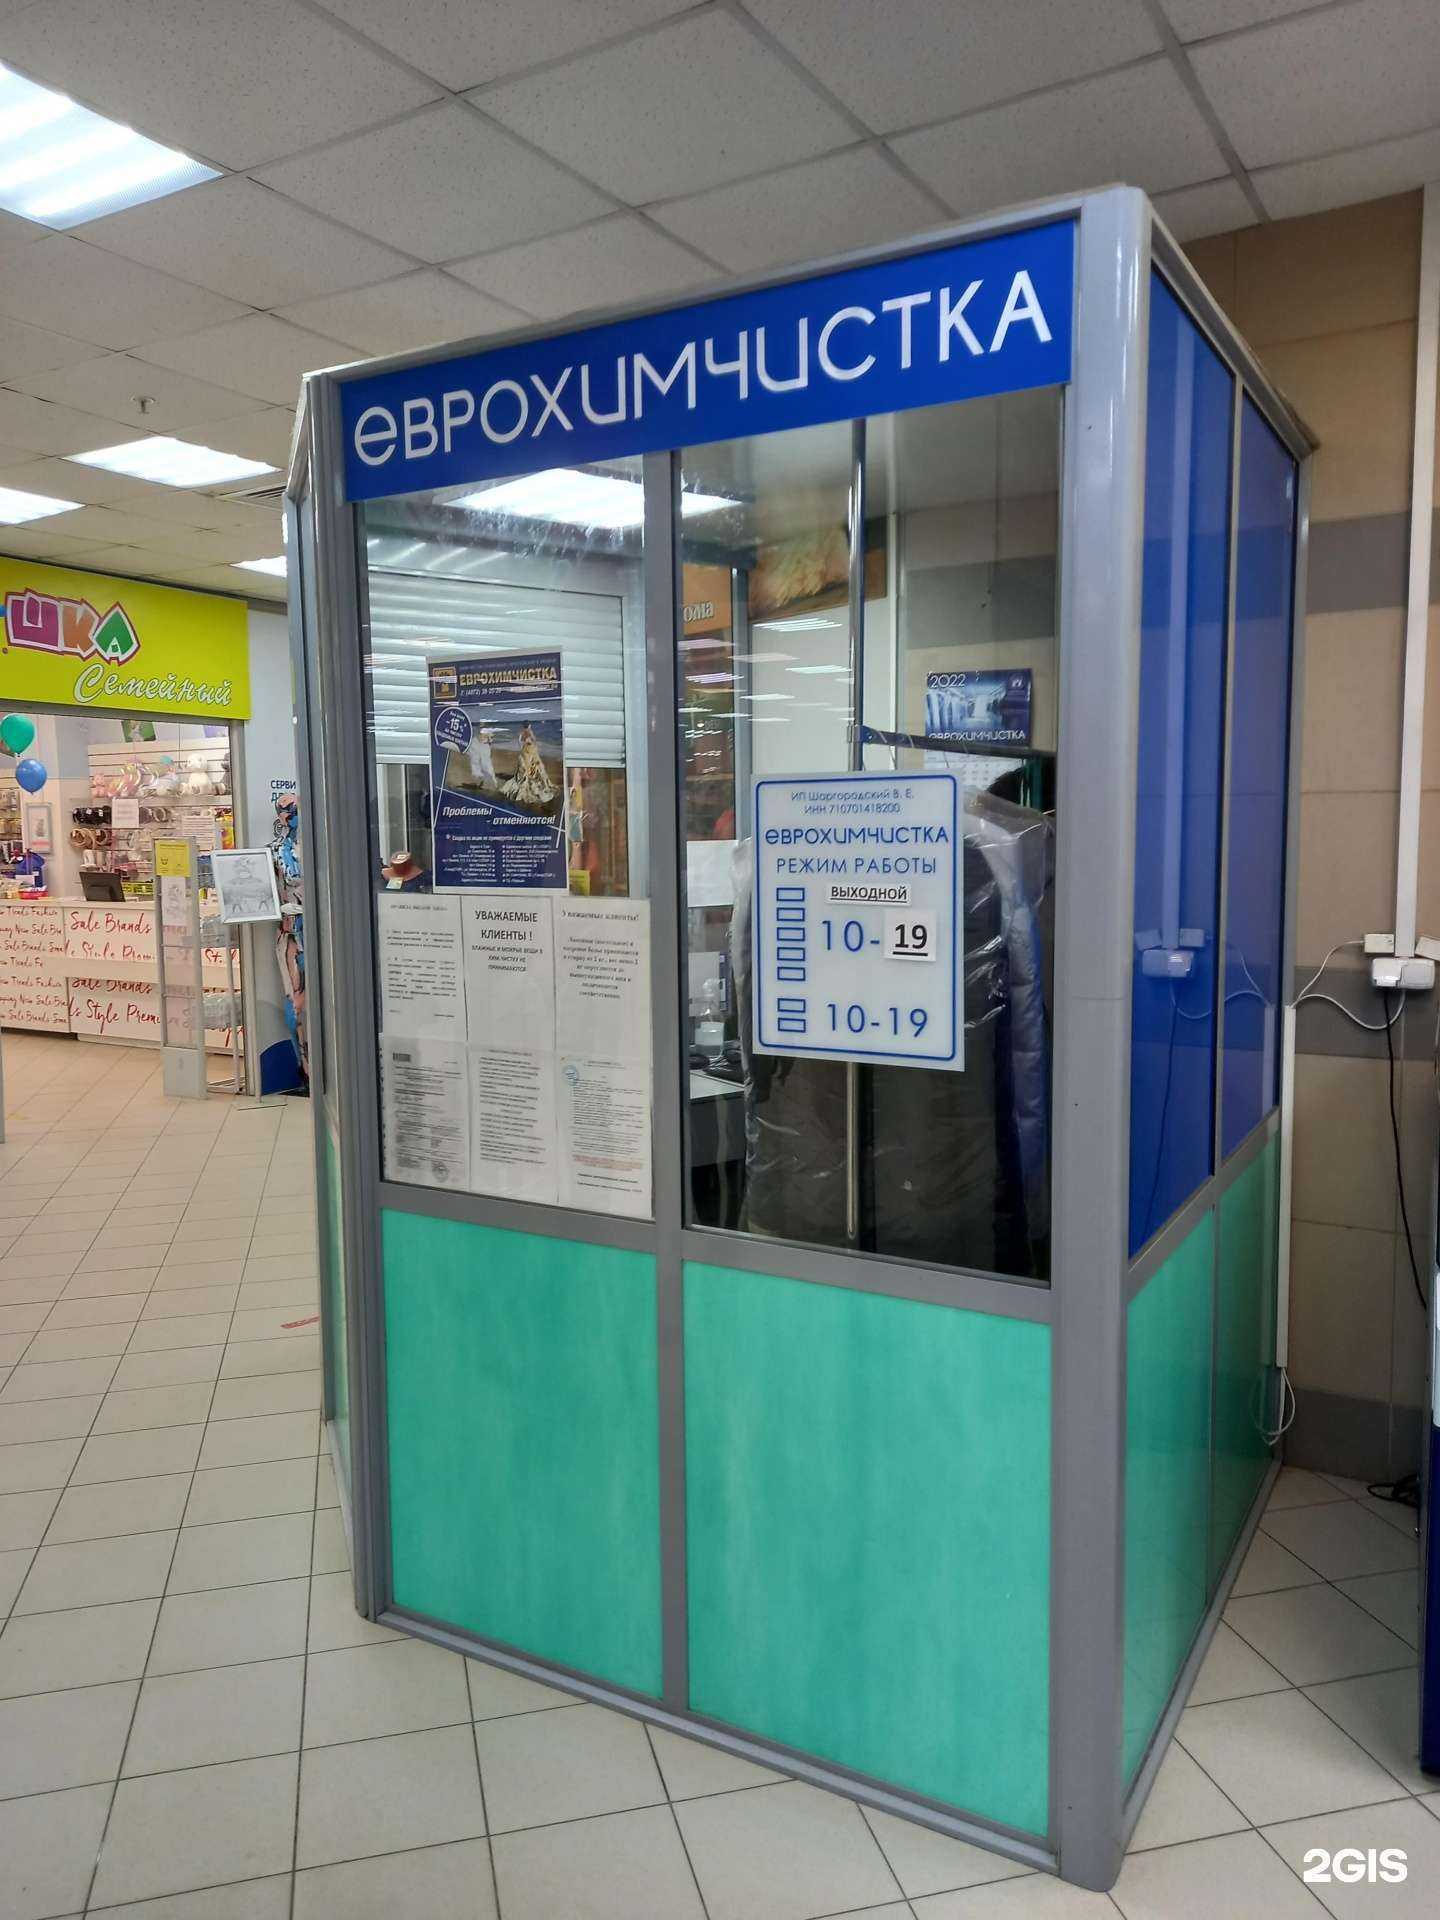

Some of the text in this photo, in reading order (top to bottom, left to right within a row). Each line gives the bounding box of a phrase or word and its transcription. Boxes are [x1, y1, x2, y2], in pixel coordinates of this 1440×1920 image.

[0, 588, 140, 666] ШКА
[74, 663, 233, 706] Семейный
[459, 667, 558, 687] ЕВРОХИМЧИСТКА
[928, 674, 967, 689] 2022
[270, 780, 297, 790] СЕРВИ
[791, 791, 806, 801] ИП
[808, 788, 890, 802] Шаргородский
[442, 806, 492, 818] Проблемы
[804, 804, 828, 814] ИНН
[492, 815, 556, 826] отменяются!
[776, 857, 937, 874] РЕЖИМ РАБОТЫ
[830, 885, 908, 902] ВЫХОДНОЙ
[70, 910, 152, 934] Sale Brands
[475, 910, 539, 923] УВАЖАЕМЫЕ
[480, 929, 527, 941] КЛИЕНТЫ
[86, 999, 119, 1034] Style
[827, 1003, 929, 1038] 10-19
